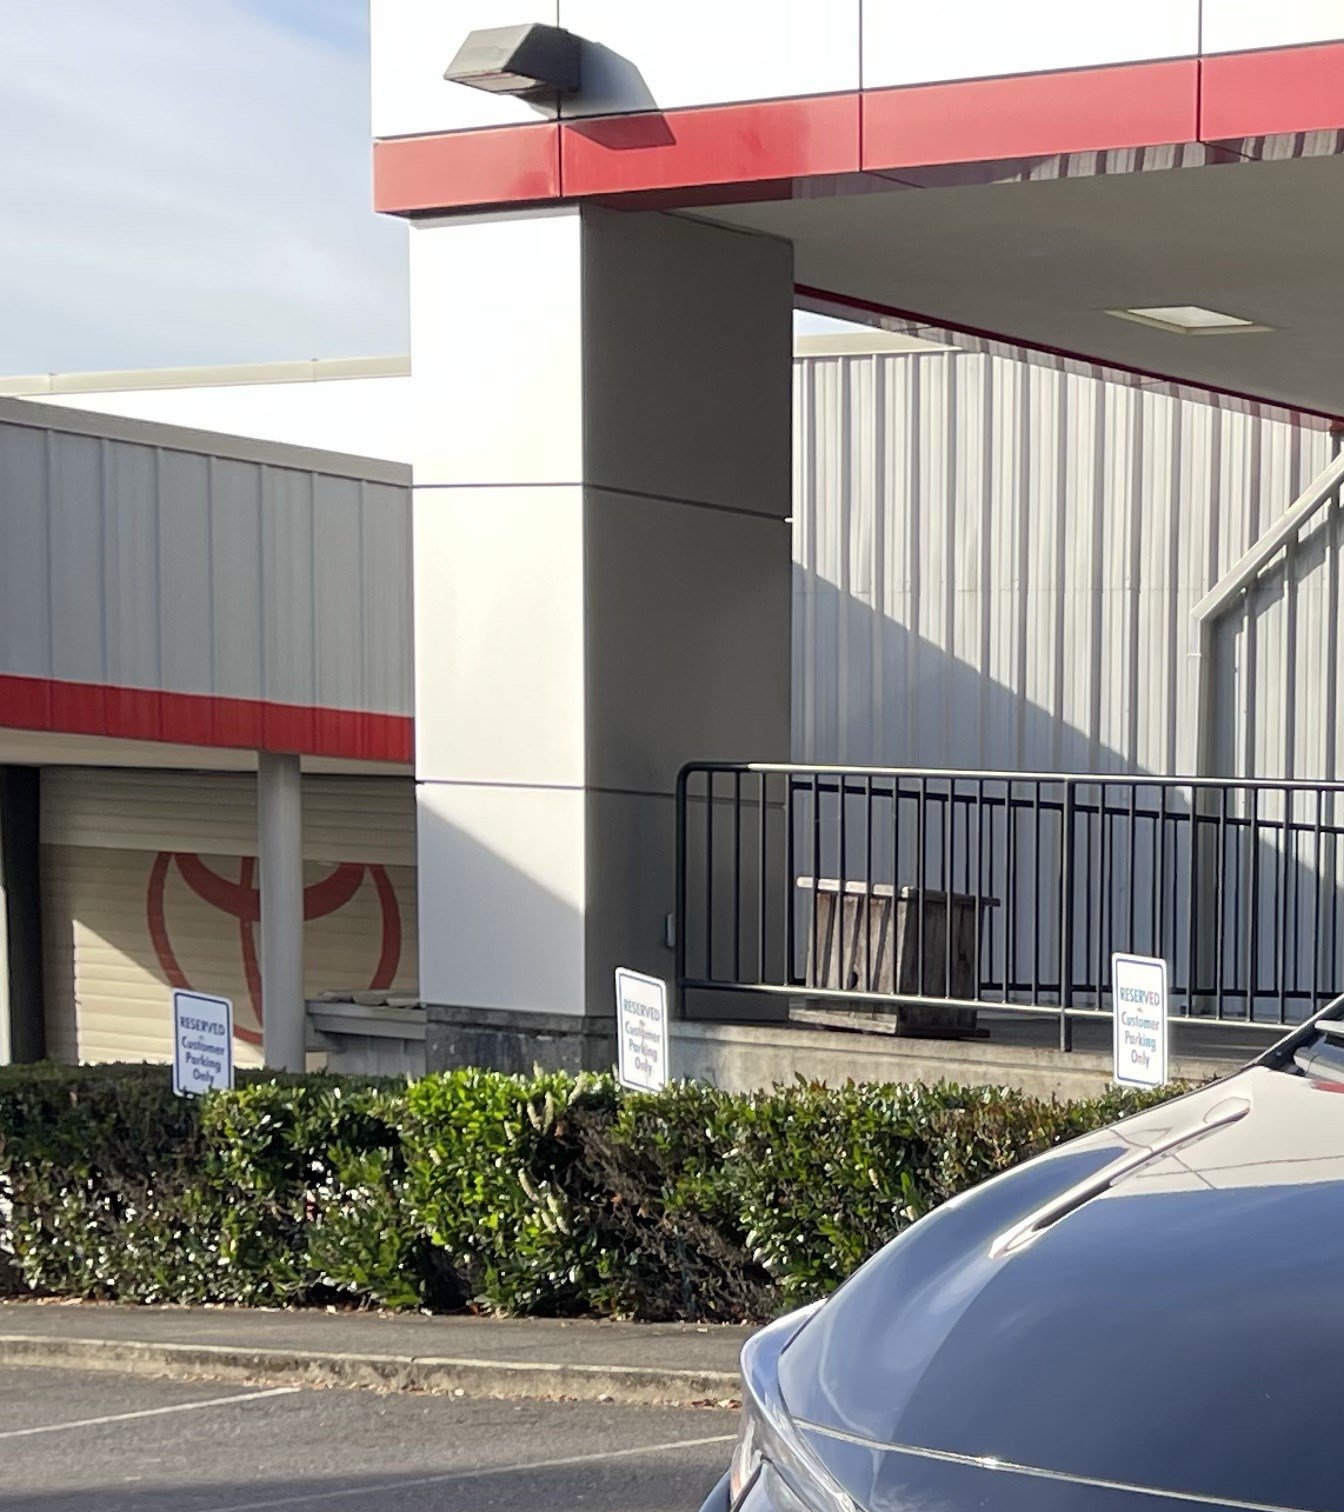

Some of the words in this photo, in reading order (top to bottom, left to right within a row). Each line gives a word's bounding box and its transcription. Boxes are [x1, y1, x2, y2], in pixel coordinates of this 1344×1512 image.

[1119, 987, 1160, 1006] RESERVED
[623, 998, 660, 1021] RESERVED
[180, 1016, 226, 1036] RESERVED
[1121, 1011, 1160, 1031] Customer
[625, 1020, 660, 1044] Customer
[1124, 1030, 1157, 1053] Parking
[181, 1036, 225, 1056] Customer
[628, 1038, 658, 1063] Parking
[185, 1051, 221, 1074] Parking
[634, 1056, 652, 1077] Only
[1131, 1049, 1151, 1069] Only
[192, 1067, 215, 1086] Only
